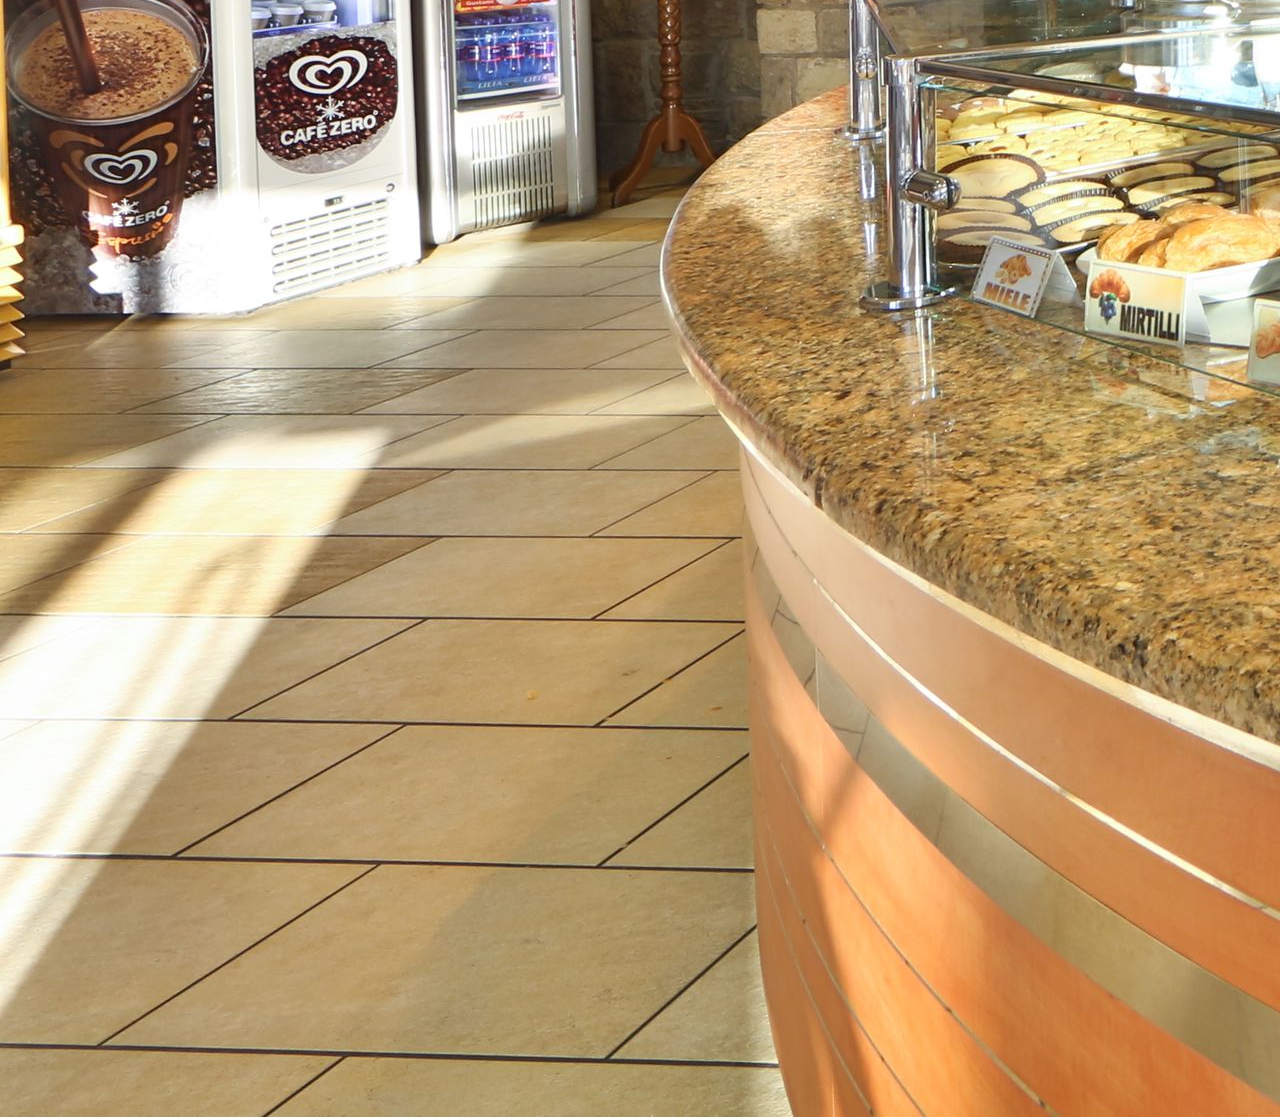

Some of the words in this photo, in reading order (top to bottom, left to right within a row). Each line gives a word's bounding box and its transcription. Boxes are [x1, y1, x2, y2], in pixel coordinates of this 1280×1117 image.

[280, 122, 328, 146] CAFÉ
[329, 114, 377, 136] ZERO
[124, 205, 168, 227] ZERO
[982, 281, 1032, 311] MIELE
[1120, 304, 1180, 341] MIRTILLI
